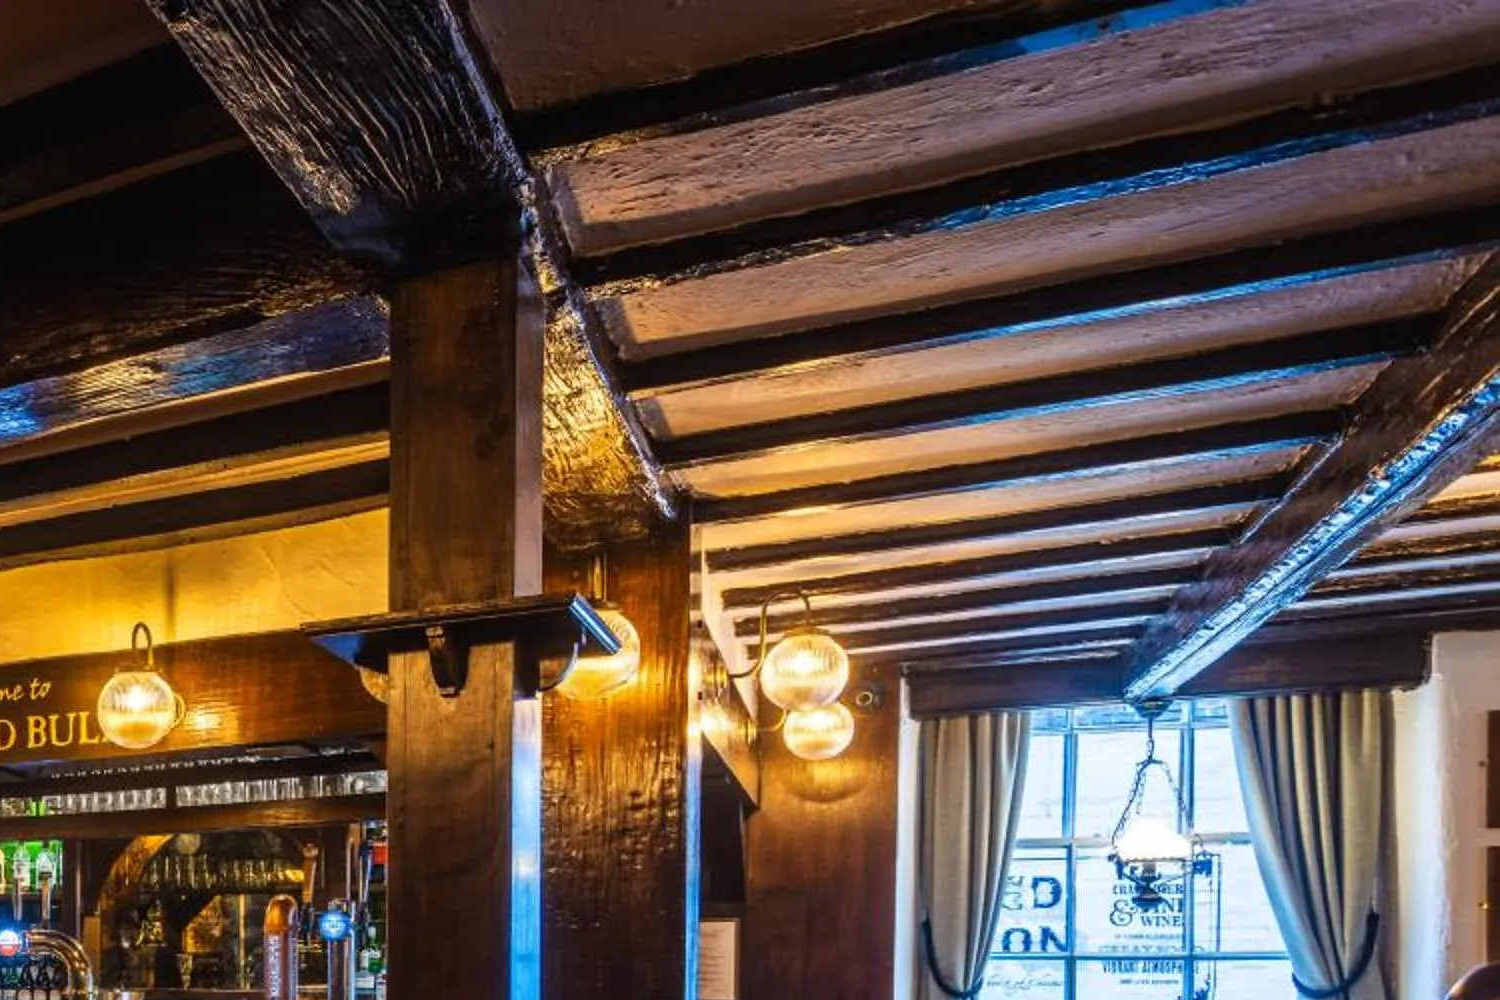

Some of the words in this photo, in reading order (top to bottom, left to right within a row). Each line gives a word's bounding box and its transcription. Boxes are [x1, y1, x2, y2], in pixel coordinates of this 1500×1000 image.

[30, 678, 52, 700] to
[27, 711, 112, 749] BUL
[1140, 915, 1186, 928] WINE
